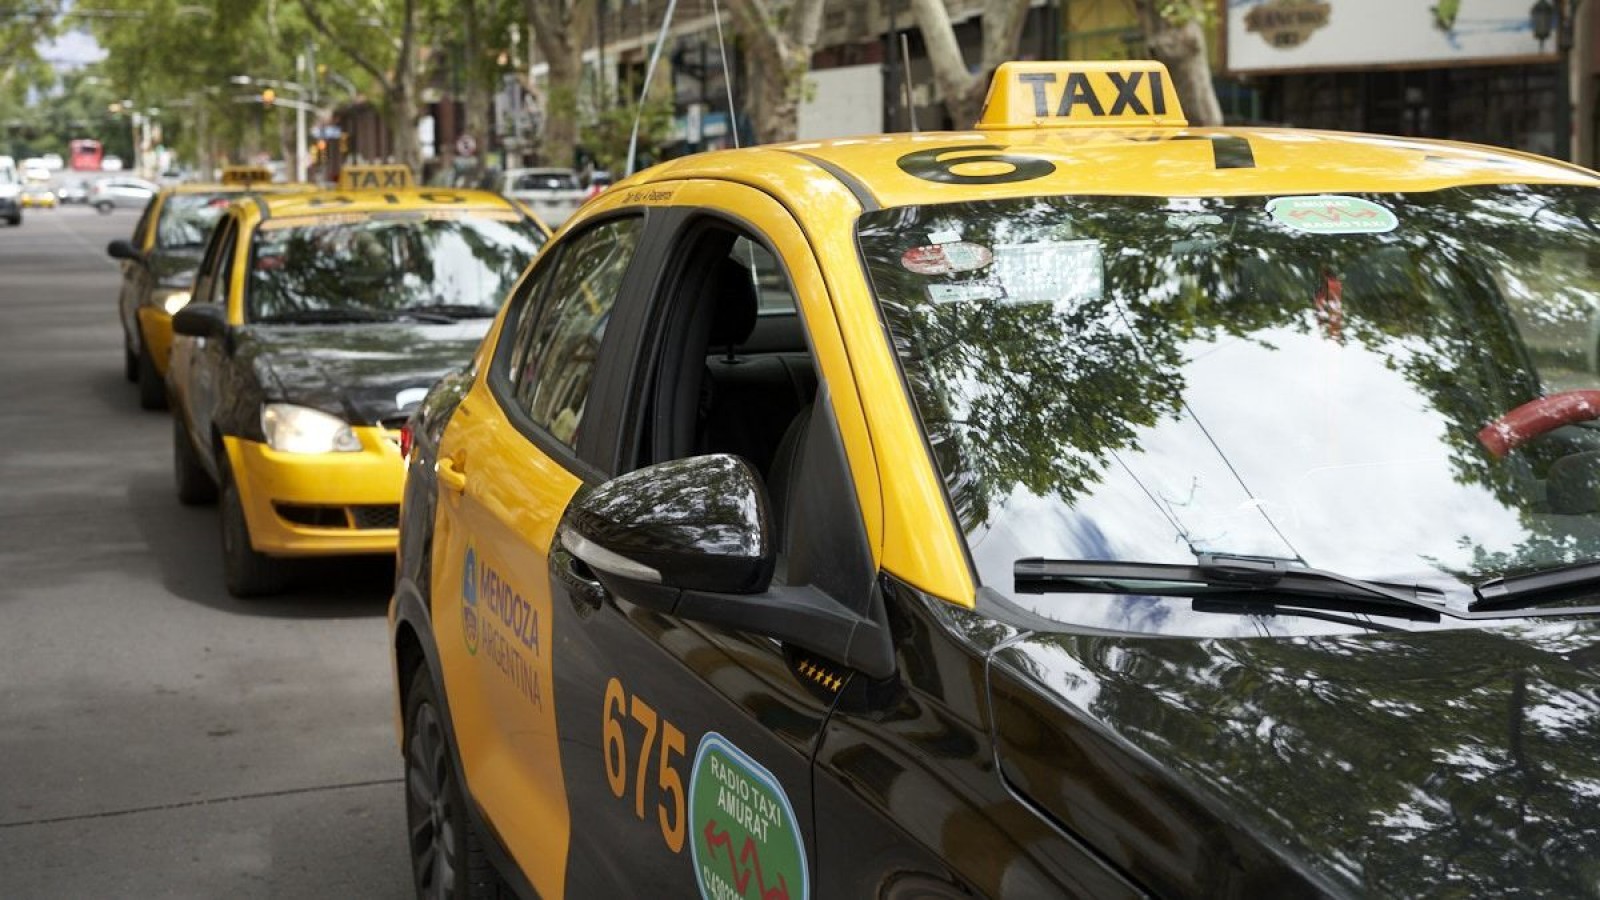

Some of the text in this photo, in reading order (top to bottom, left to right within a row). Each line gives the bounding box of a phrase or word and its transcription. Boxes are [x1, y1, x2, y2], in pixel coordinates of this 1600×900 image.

[1019, 71, 1167, 117] TAXI
[350, 171, 406, 189] TAXI
[480, 561, 539, 657] MENDOZA
[481, 616, 542, 713] ARGENTINA
[604, 678, 685, 853] 675
[711, 755, 781, 828] RADIO TAXI
[717, 786, 769, 843] AMURAT
